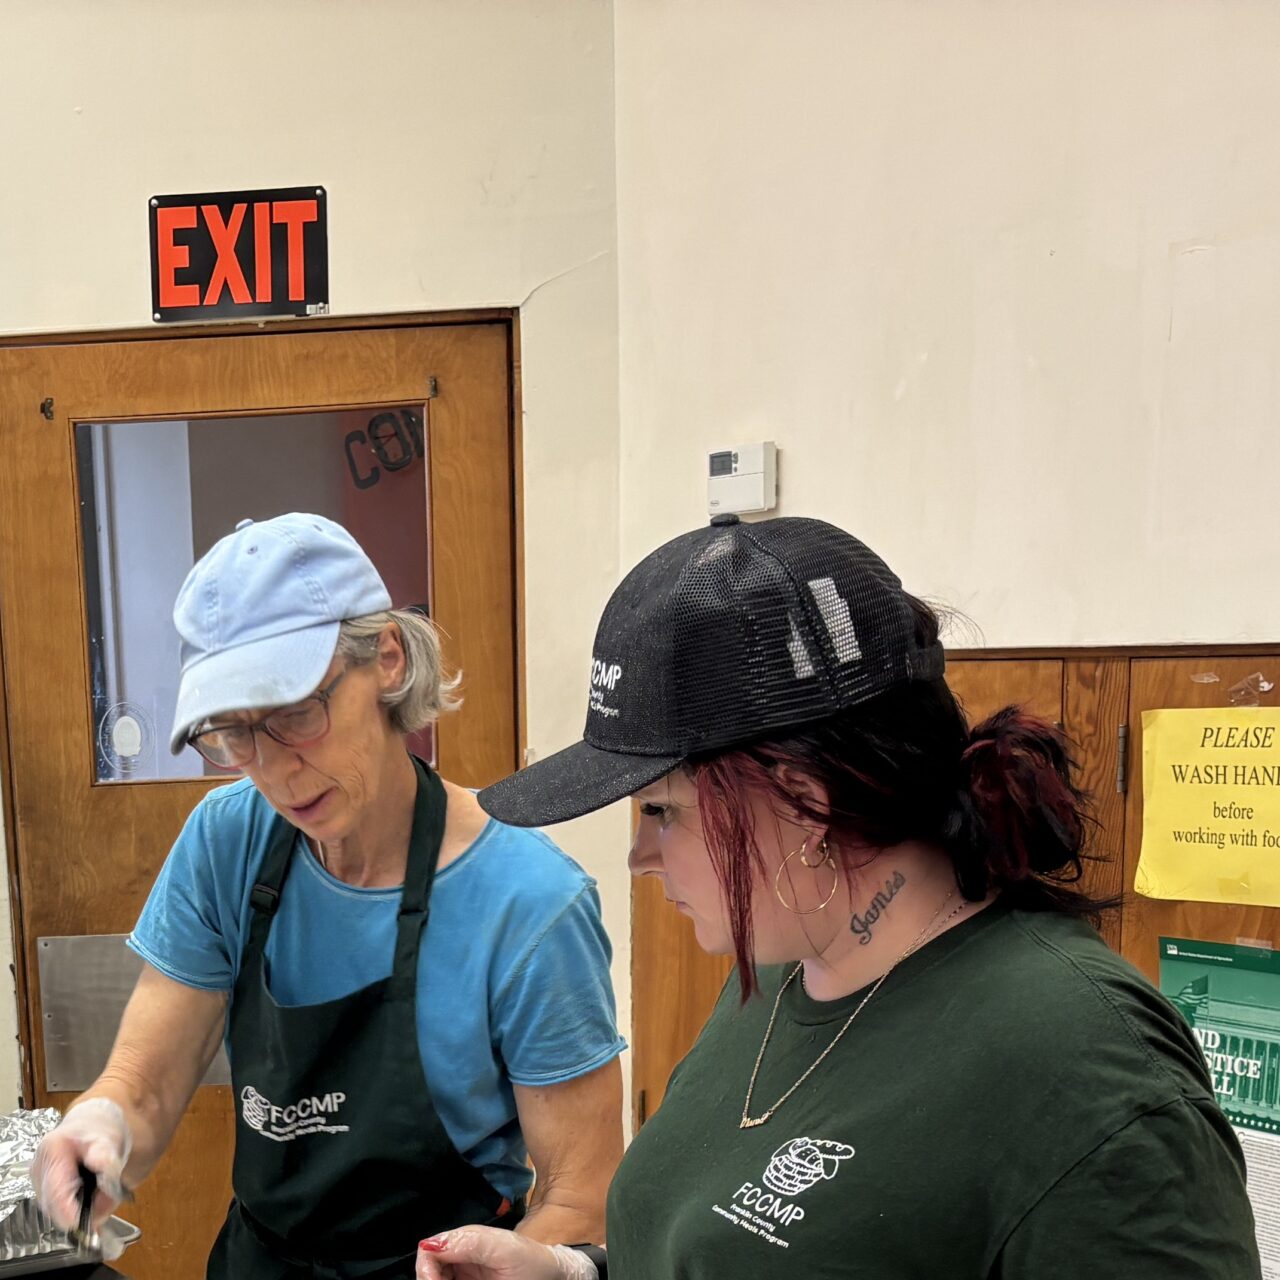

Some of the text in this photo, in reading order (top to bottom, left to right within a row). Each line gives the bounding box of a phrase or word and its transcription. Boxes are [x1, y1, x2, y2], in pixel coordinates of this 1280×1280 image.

[157, 199, 318, 308] EXIT
[1199, 726, 1276, 749] PLEASE
[1171, 764, 1228, 785] WASH
[1213, 800, 1254, 820] before
[1172, 826, 1226, 850] working
[1229, 828, 1258, 847] with
[270, 1092, 346, 1124] FCCMP
[730, 1203, 776, 1232] Franklin County
[732, 1182, 805, 1227] FCCMP
[739, 1219, 759, 1234] Meals
[758, 1229, 790, 1248] Program
